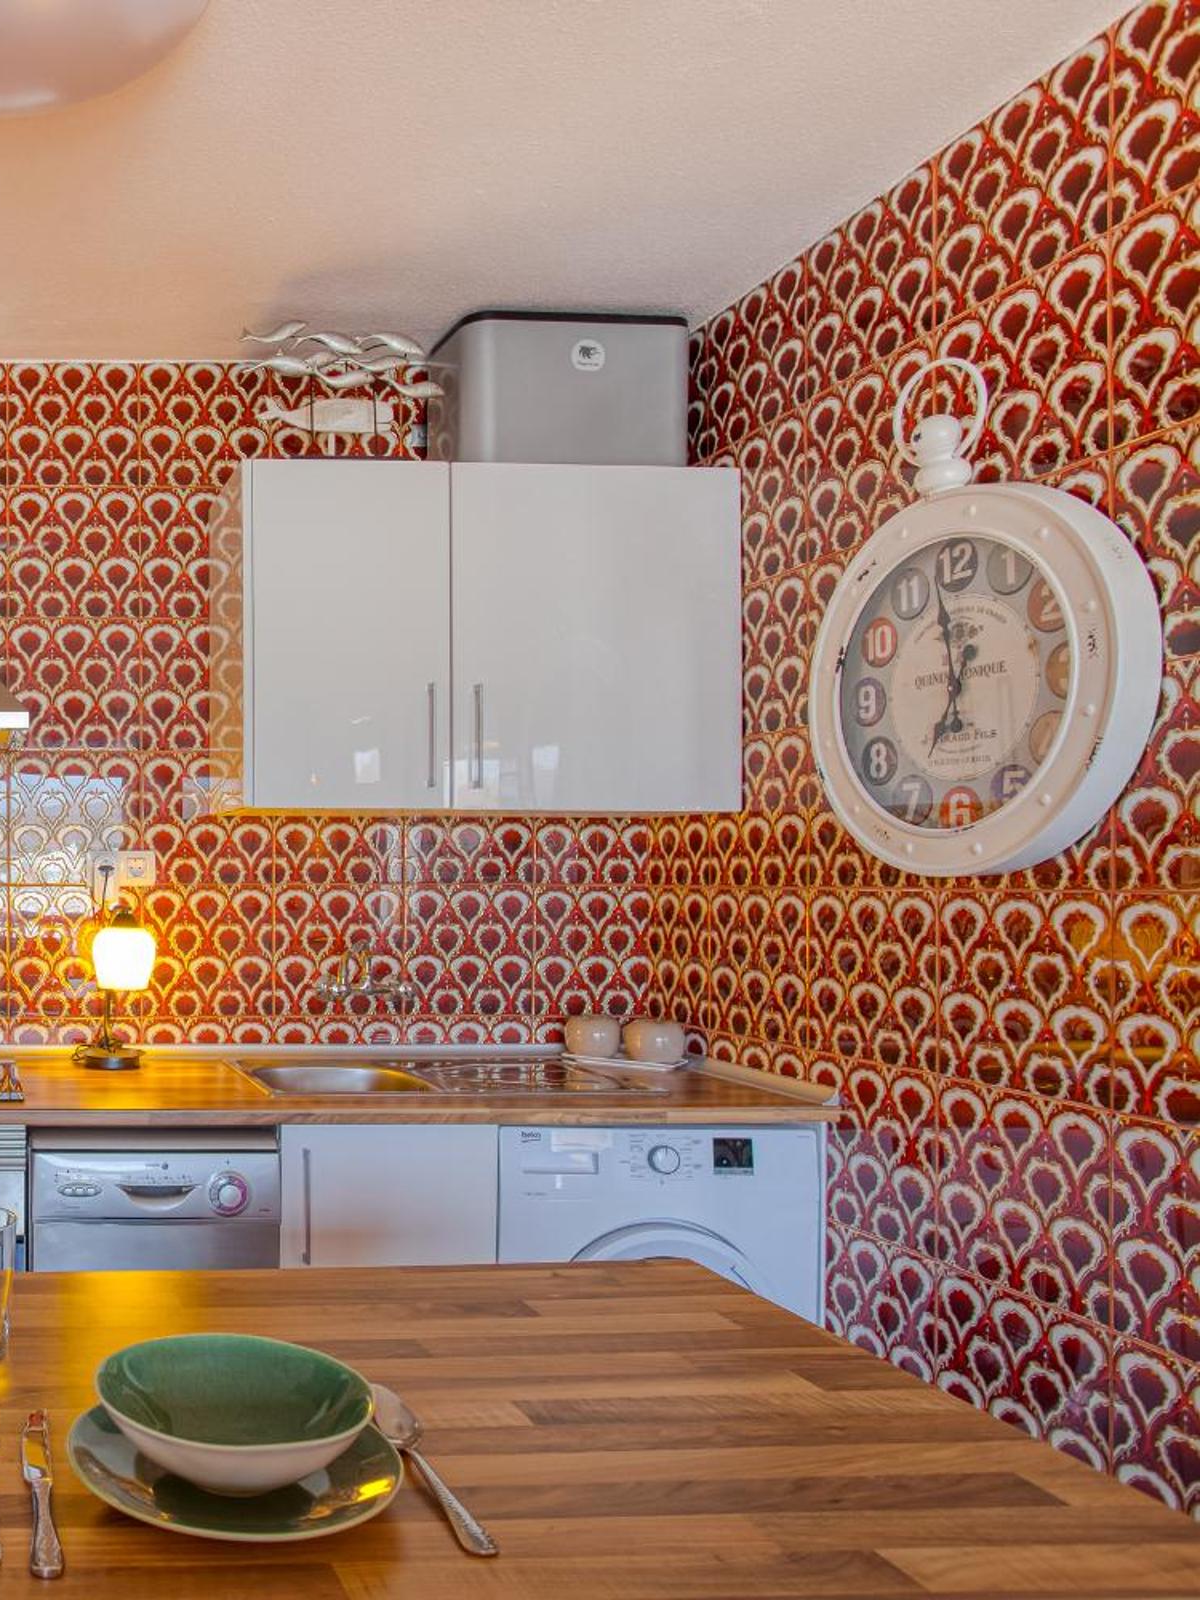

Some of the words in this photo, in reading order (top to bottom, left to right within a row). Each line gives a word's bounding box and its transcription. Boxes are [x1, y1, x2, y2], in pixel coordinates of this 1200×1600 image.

[939, 542, 973, 585] 12
[1001, 549, 1016, 585] 1
[897, 575, 919, 613] 11
[864, 624, 894, 664] 10
[857, 686, 878, 724] 9
[870, 742, 889, 780] 8
[899, 782, 921, 826] 7
[1002, 769, 1026, 803] 5
[949, 793, 972, 829] 6
